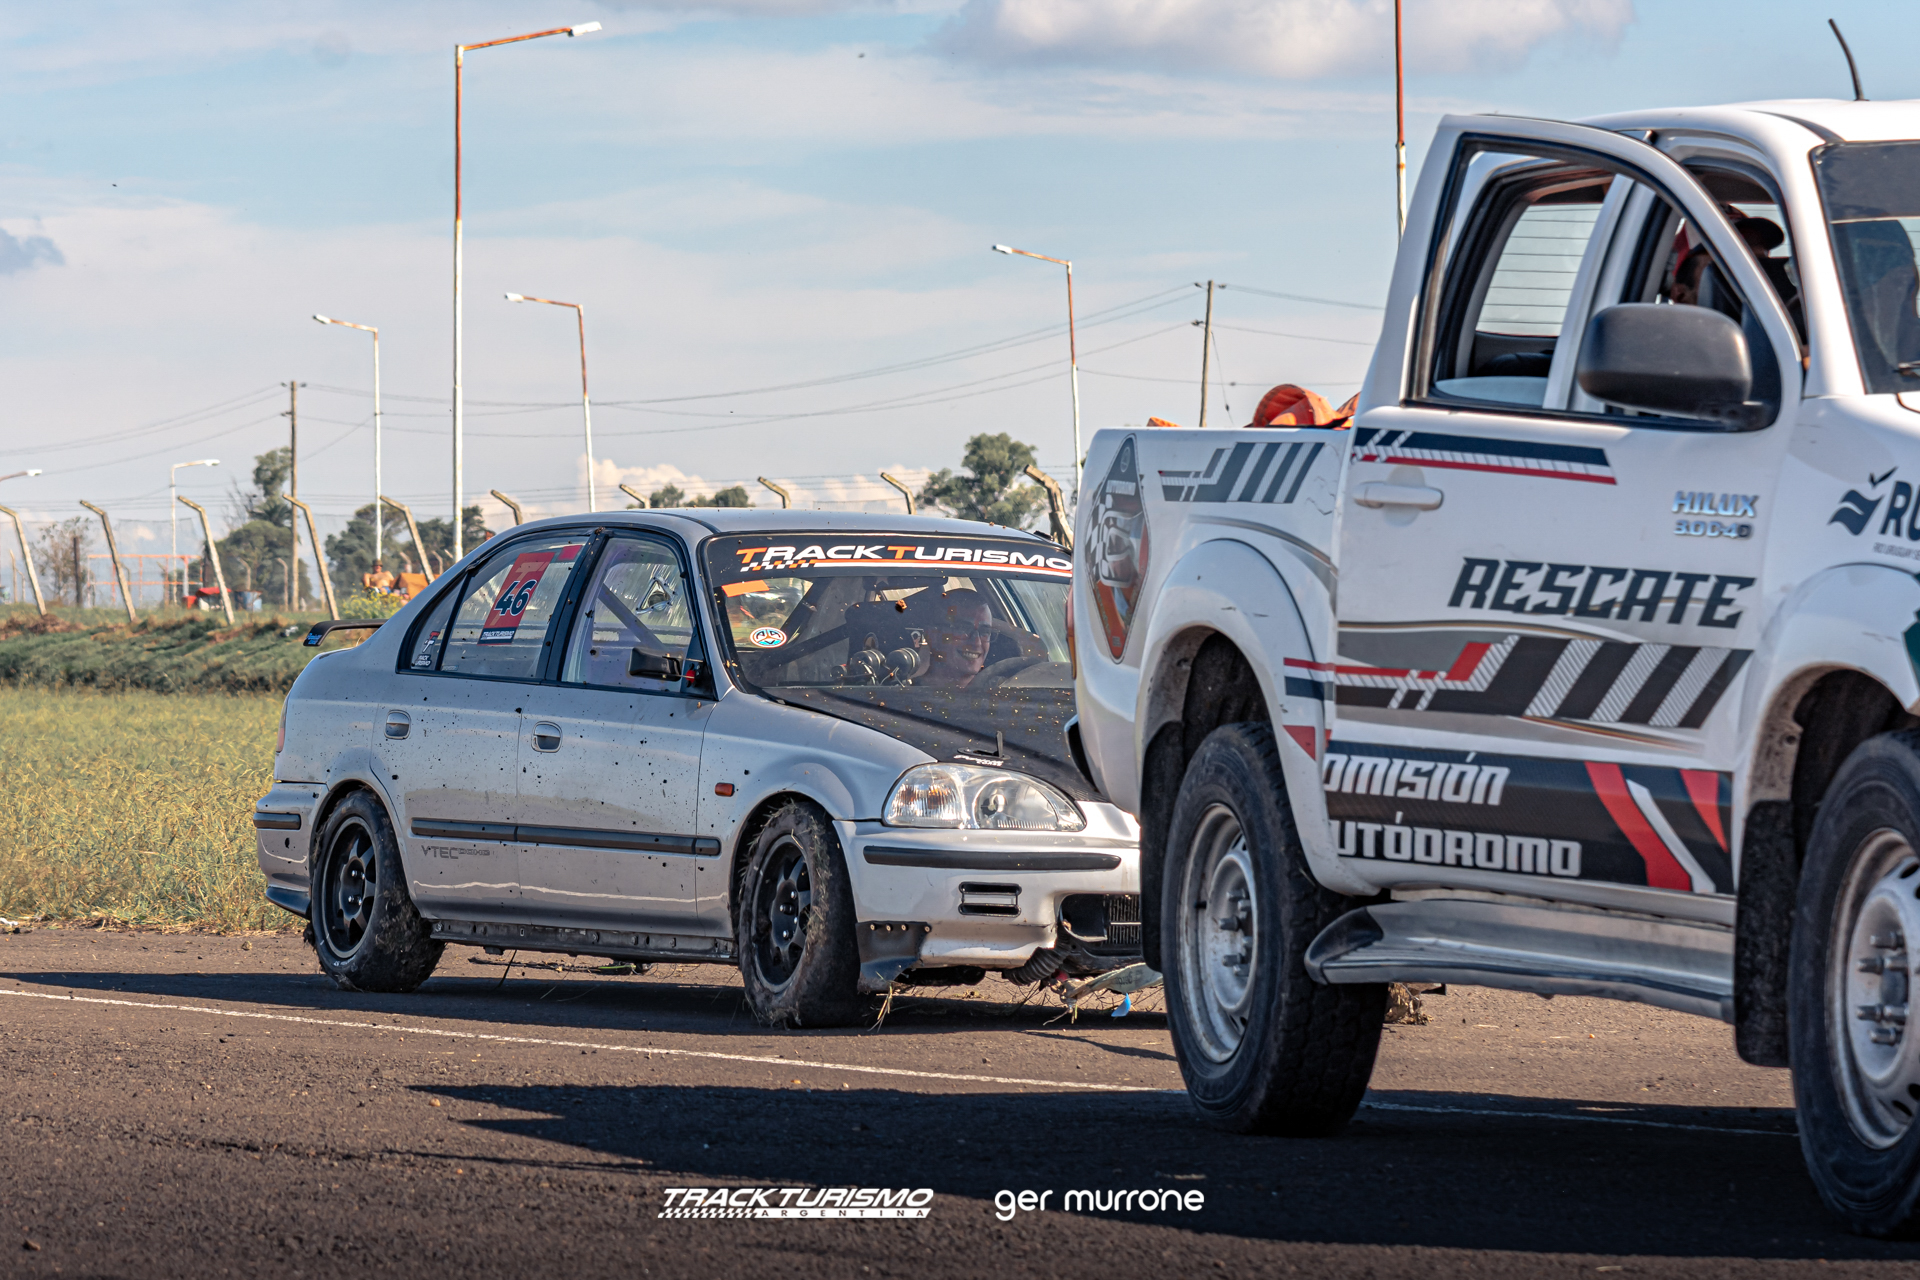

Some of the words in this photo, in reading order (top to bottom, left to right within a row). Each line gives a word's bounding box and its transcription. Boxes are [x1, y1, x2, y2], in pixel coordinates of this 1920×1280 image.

[1671, 491, 1759, 517] HILUX
[494, 579, 537, 616] 46
[1447, 557, 1757, 629] RESCATE
[421, 845, 458, 859] VTEC
